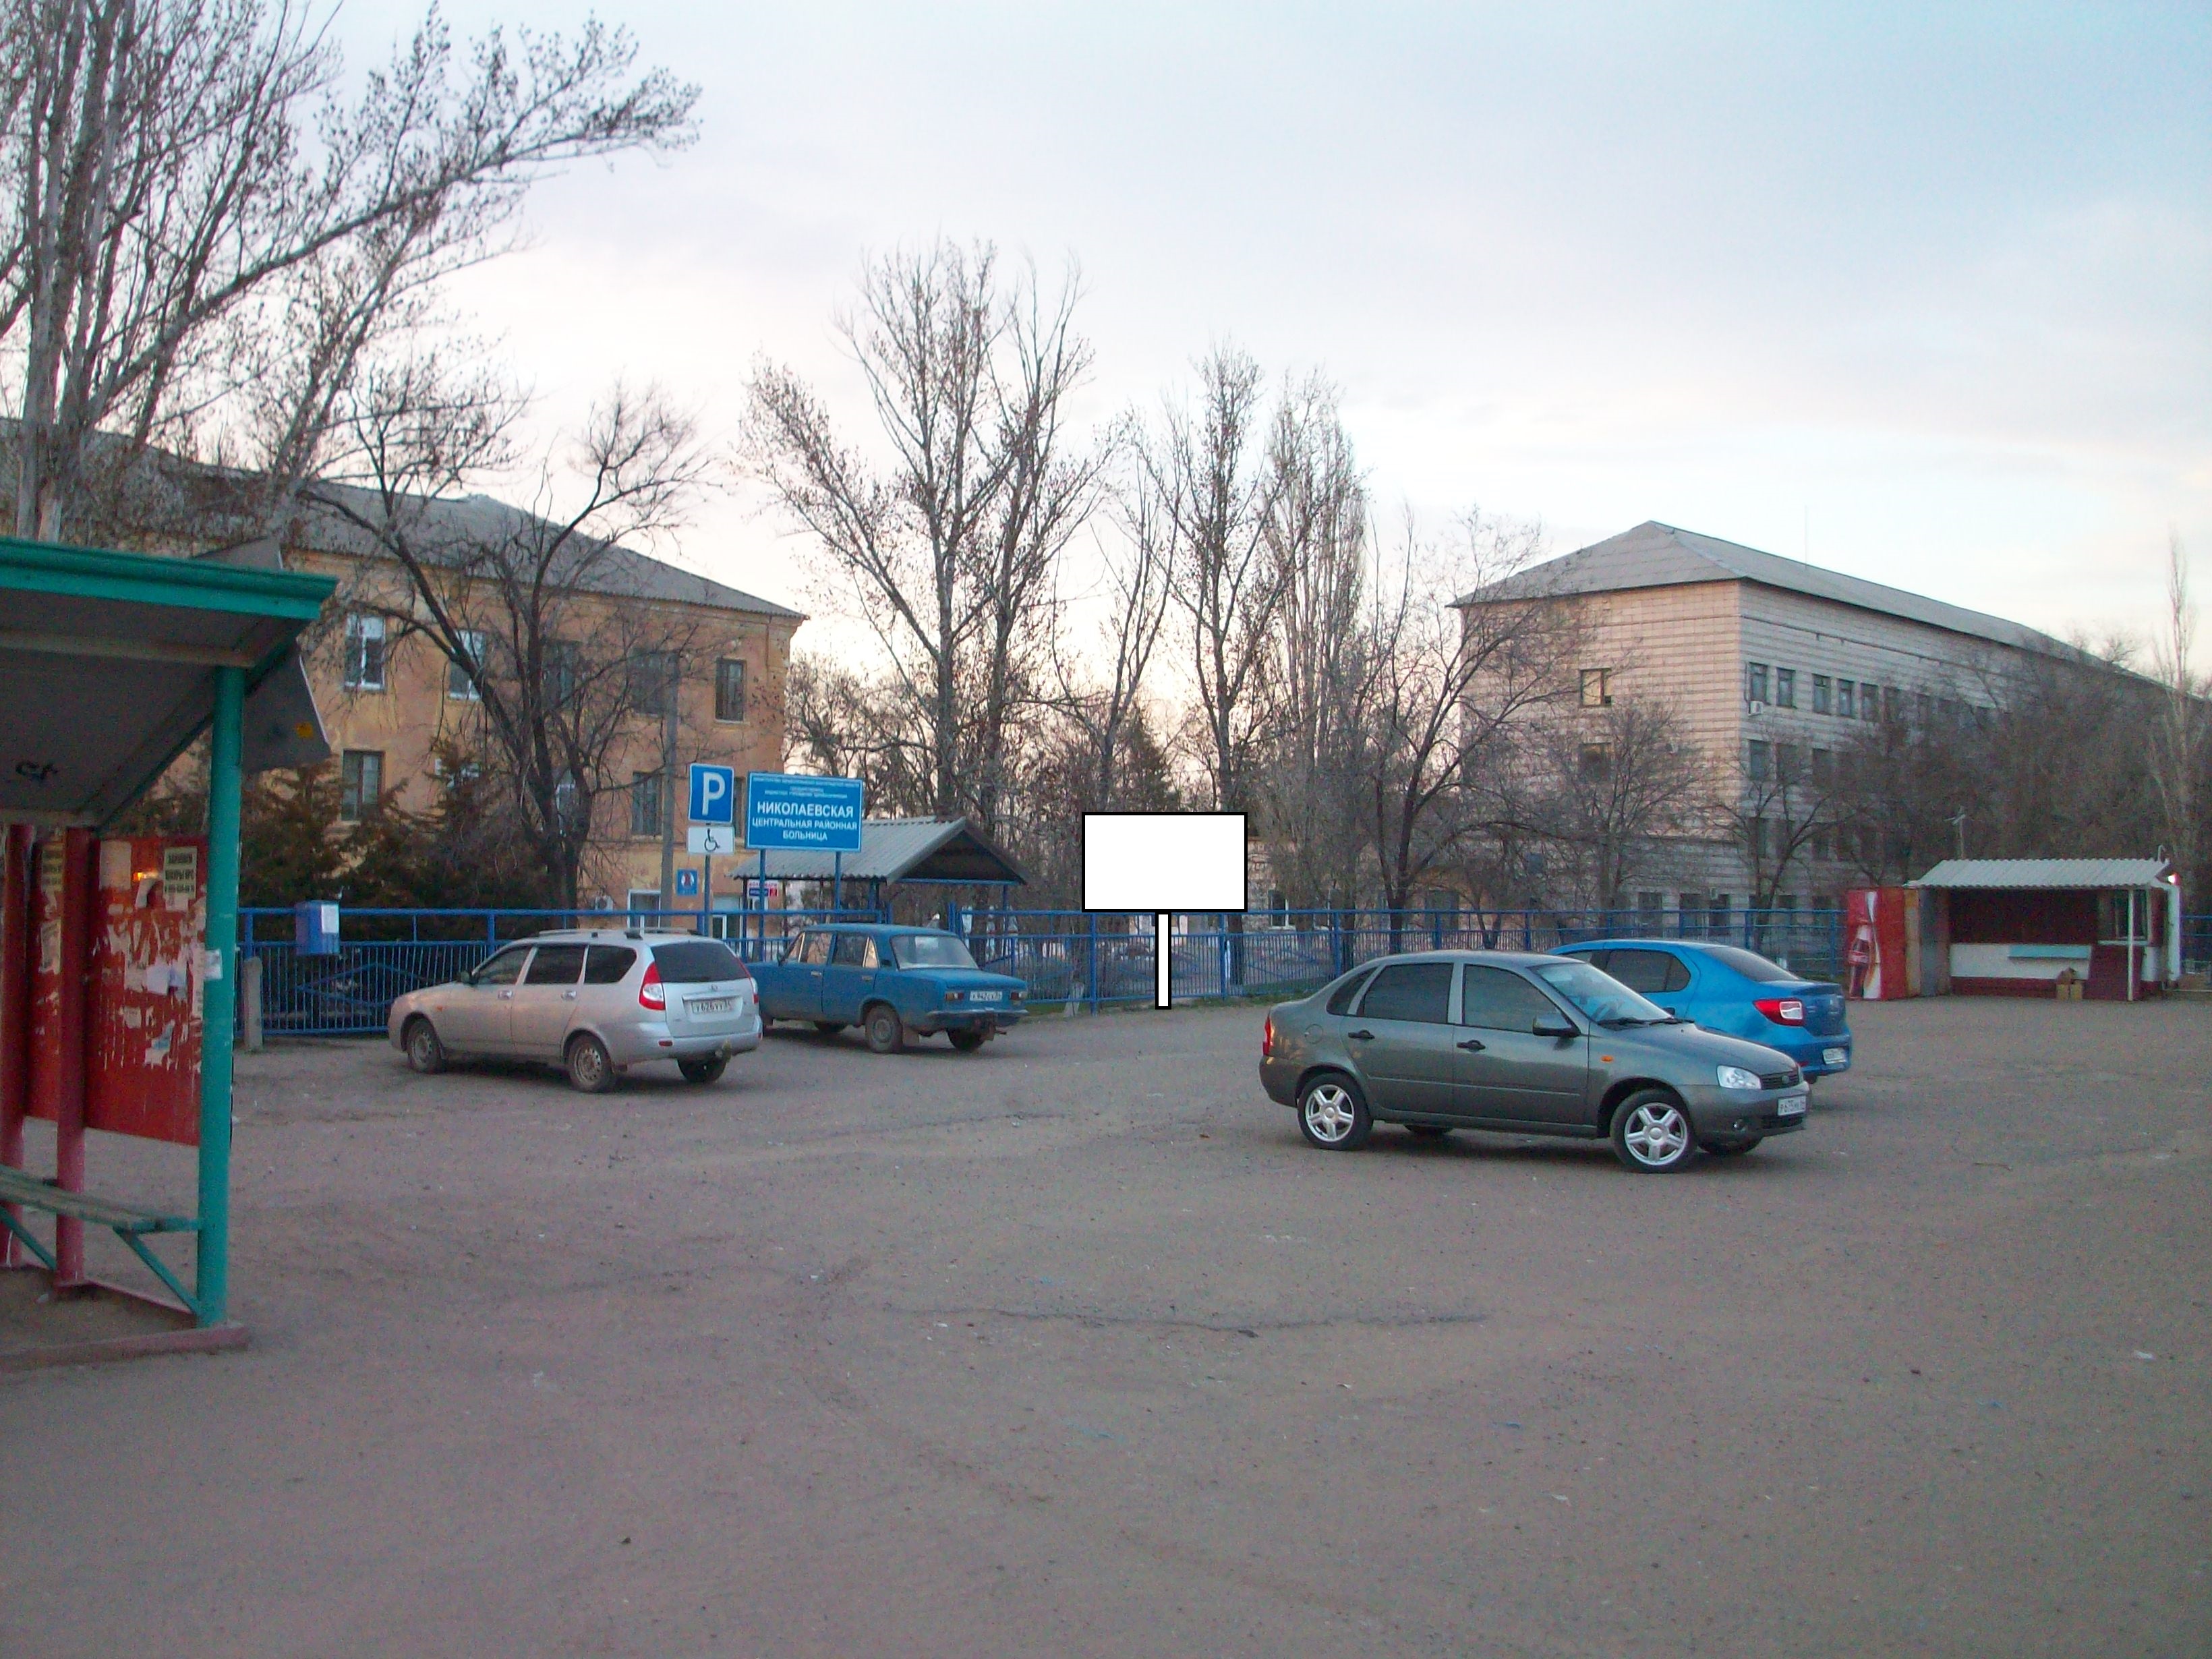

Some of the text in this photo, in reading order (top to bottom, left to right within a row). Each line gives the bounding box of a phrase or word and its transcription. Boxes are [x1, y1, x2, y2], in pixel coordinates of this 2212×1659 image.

[757, 801, 854, 818] НИКОЛАЕВСКАЯ
[752, 817, 858, 831] ЦЕНТРАЛЬНАЯ РАЙОННАЯ
[782, 830, 828, 842] БОЛЬНИЦА
